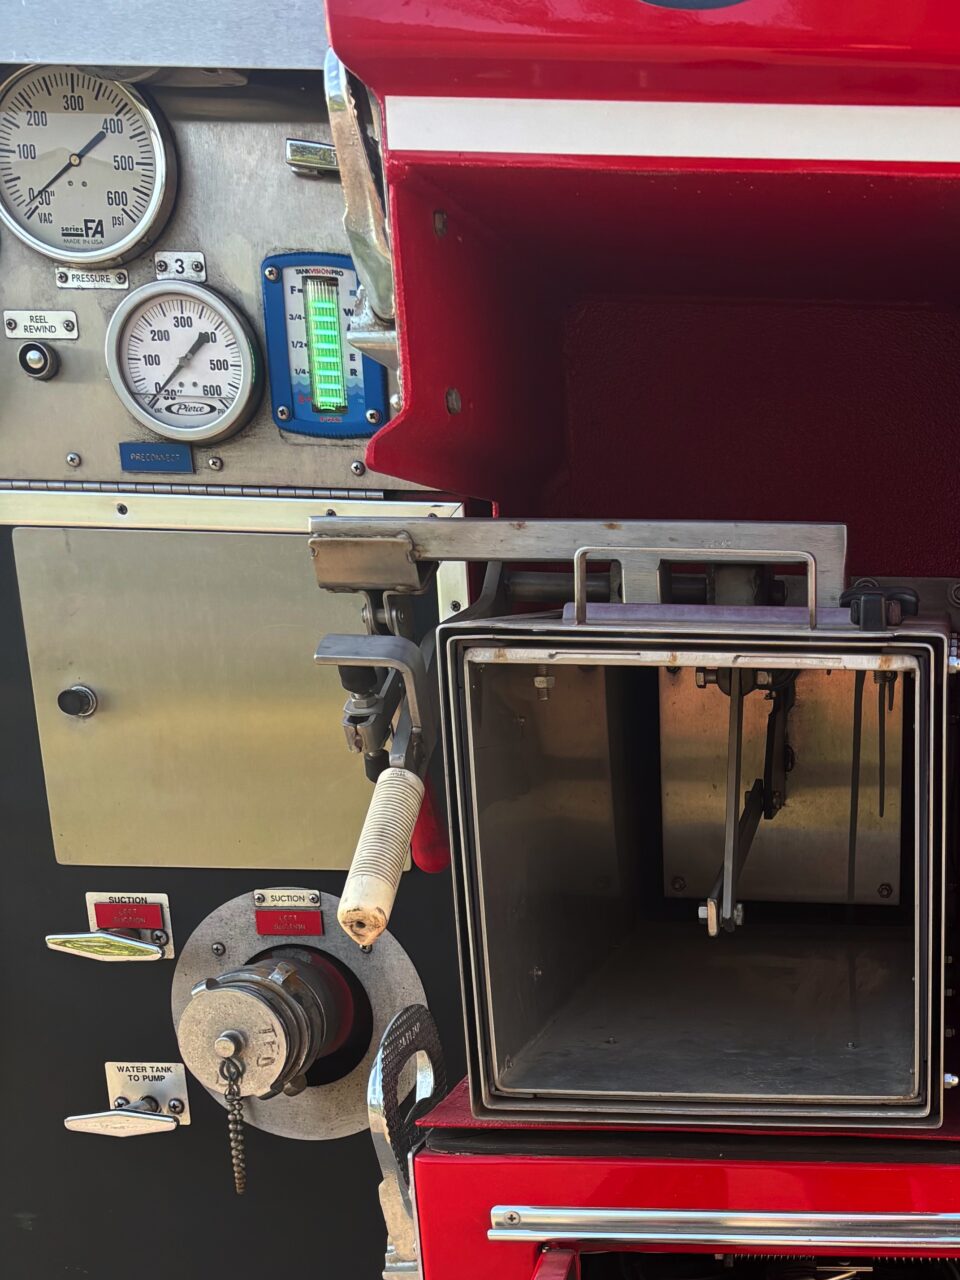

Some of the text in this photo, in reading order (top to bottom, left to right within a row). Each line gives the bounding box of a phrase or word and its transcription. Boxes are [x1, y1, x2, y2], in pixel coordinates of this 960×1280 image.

[63, 95, 84, 111] 300
[27, 111, 48, 126] 200
[102, 118, 123, 134] 400
[17, 144, 36, 160] 100
[113, 155, 134, 171] 500
[107, 191, 128, 206] 600
[38, 212, 53, 224] VAC
[112, 214, 125, 228] psi
[61, 218, 105, 238] series FA
[175, 258, 185, 274] 3
[71, 273, 111, 283] PRESSURE
[290, 286, 297, 295] F
[29, 315, 49, 324] REEL
[173, 315, 193, 329] 300
[289, 313, 302, 321] 3/4
[23, 324, 57, 334] REWIND
[150, 329, 170, 342] 200
[142, 353, 161, 366] 100
[209, 359, 229, 371] 500
[202, 384, 222, 397] 600
[176, 402, 205, 415] Pierce
[108, 896, 148, 905] SUCTION
[270, 894, 306, 902] SUCTION
[116, 1065, 147, 1073] WATER
[127, 1074, 166, 1082] TO PUMP
